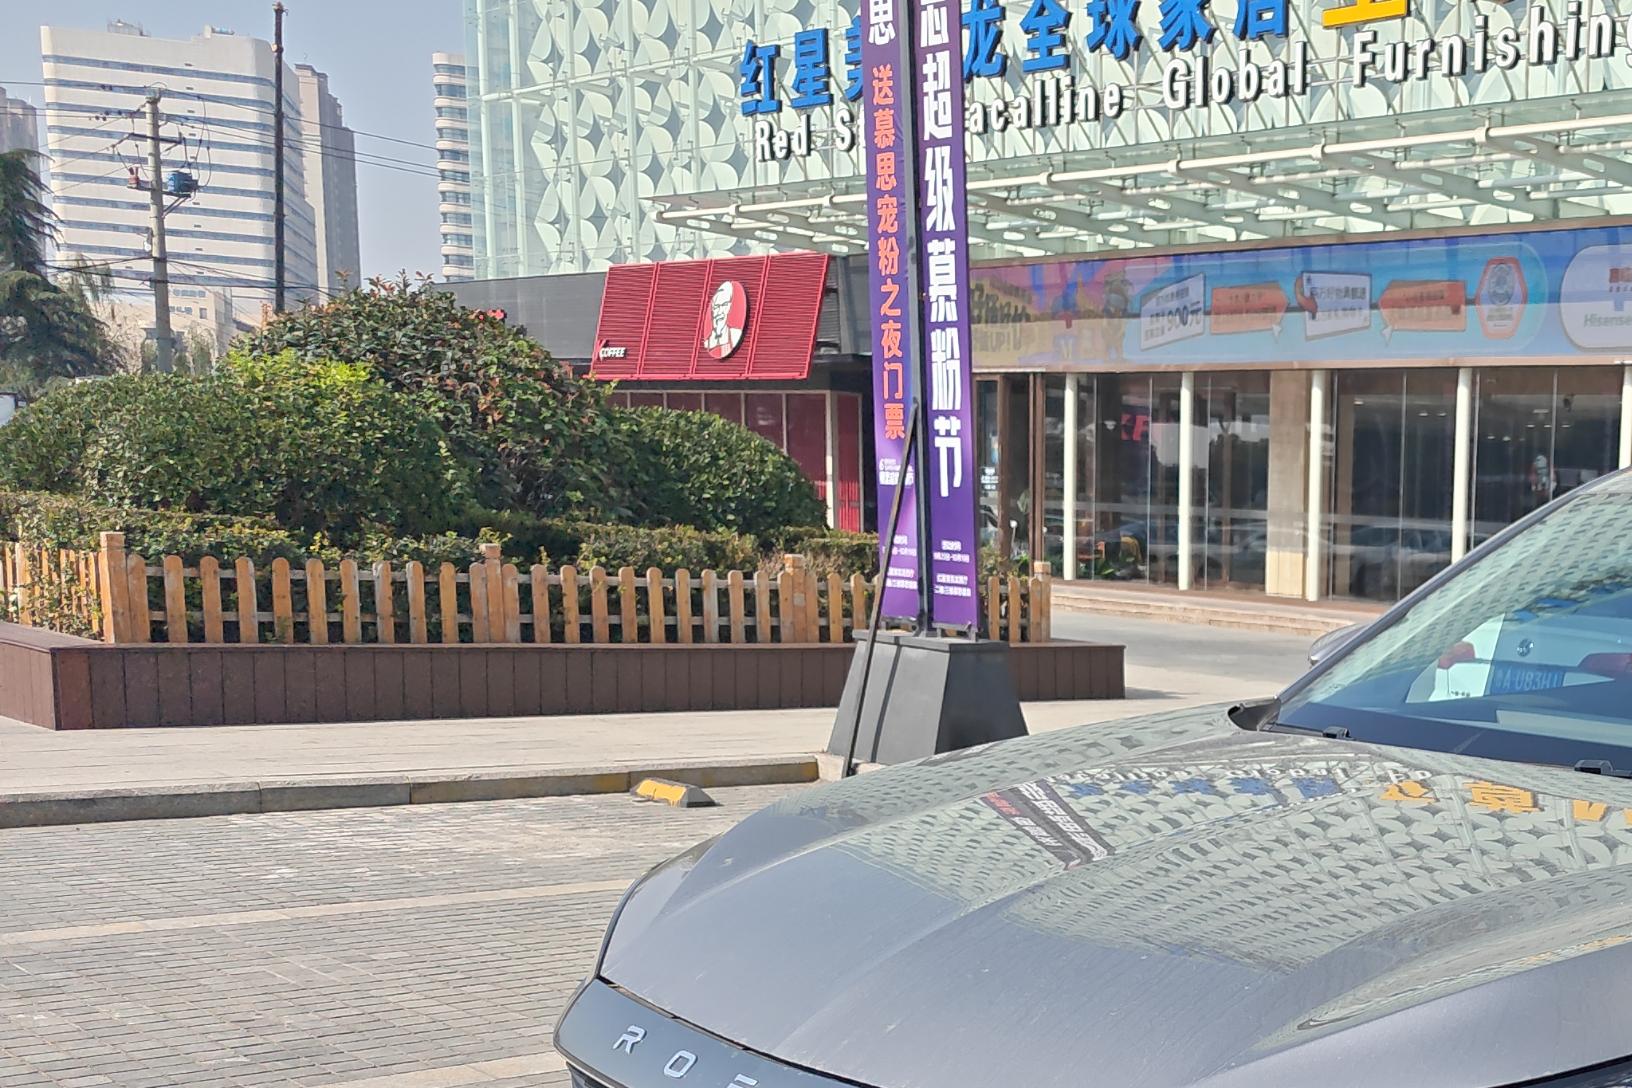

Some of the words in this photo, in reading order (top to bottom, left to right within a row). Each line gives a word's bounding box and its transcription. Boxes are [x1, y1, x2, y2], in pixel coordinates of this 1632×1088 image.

[756, 106, 812, 162] Red
[965, 73, 1124, 135] acalline
[1163, 41, 1308, 109] Global
[872, 63, 906, 440] 送慕思宠粉之夜门票
[600, 347, 626, 358] COFFEE
